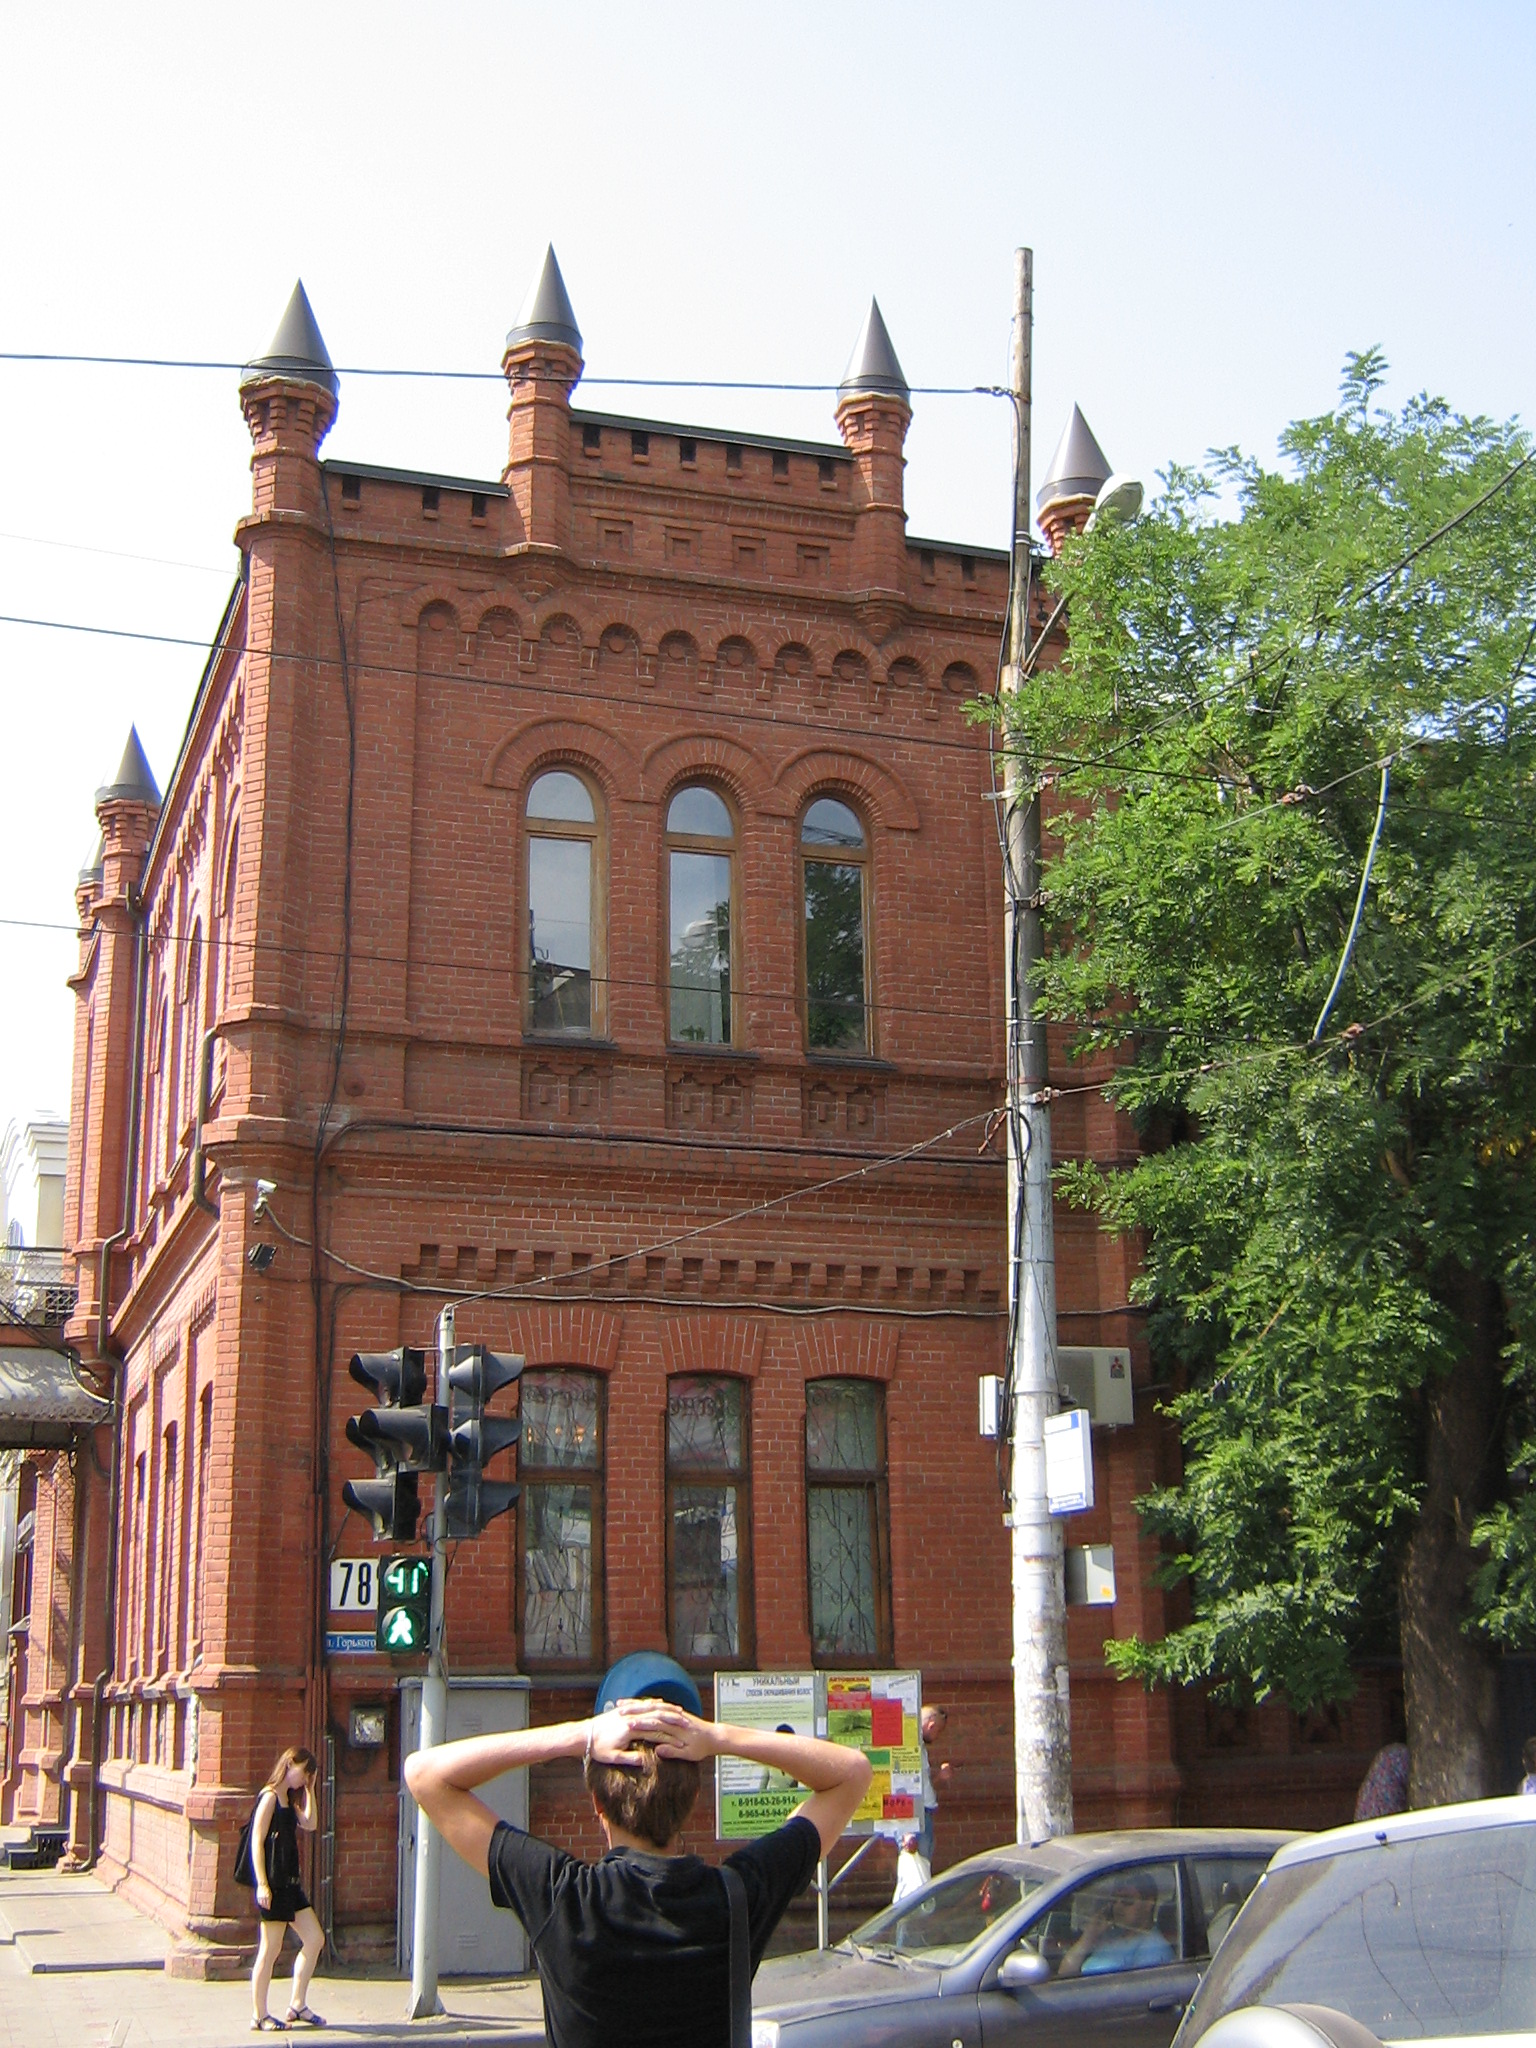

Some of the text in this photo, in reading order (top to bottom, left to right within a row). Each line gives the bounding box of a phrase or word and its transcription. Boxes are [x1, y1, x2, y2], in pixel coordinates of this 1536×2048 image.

[339, 1562, 371, 1606] 78
[336, 1635, 376, 1650] Горького
[752, 1676, 800, 1687] УНИКАЛЬНЫЙ
